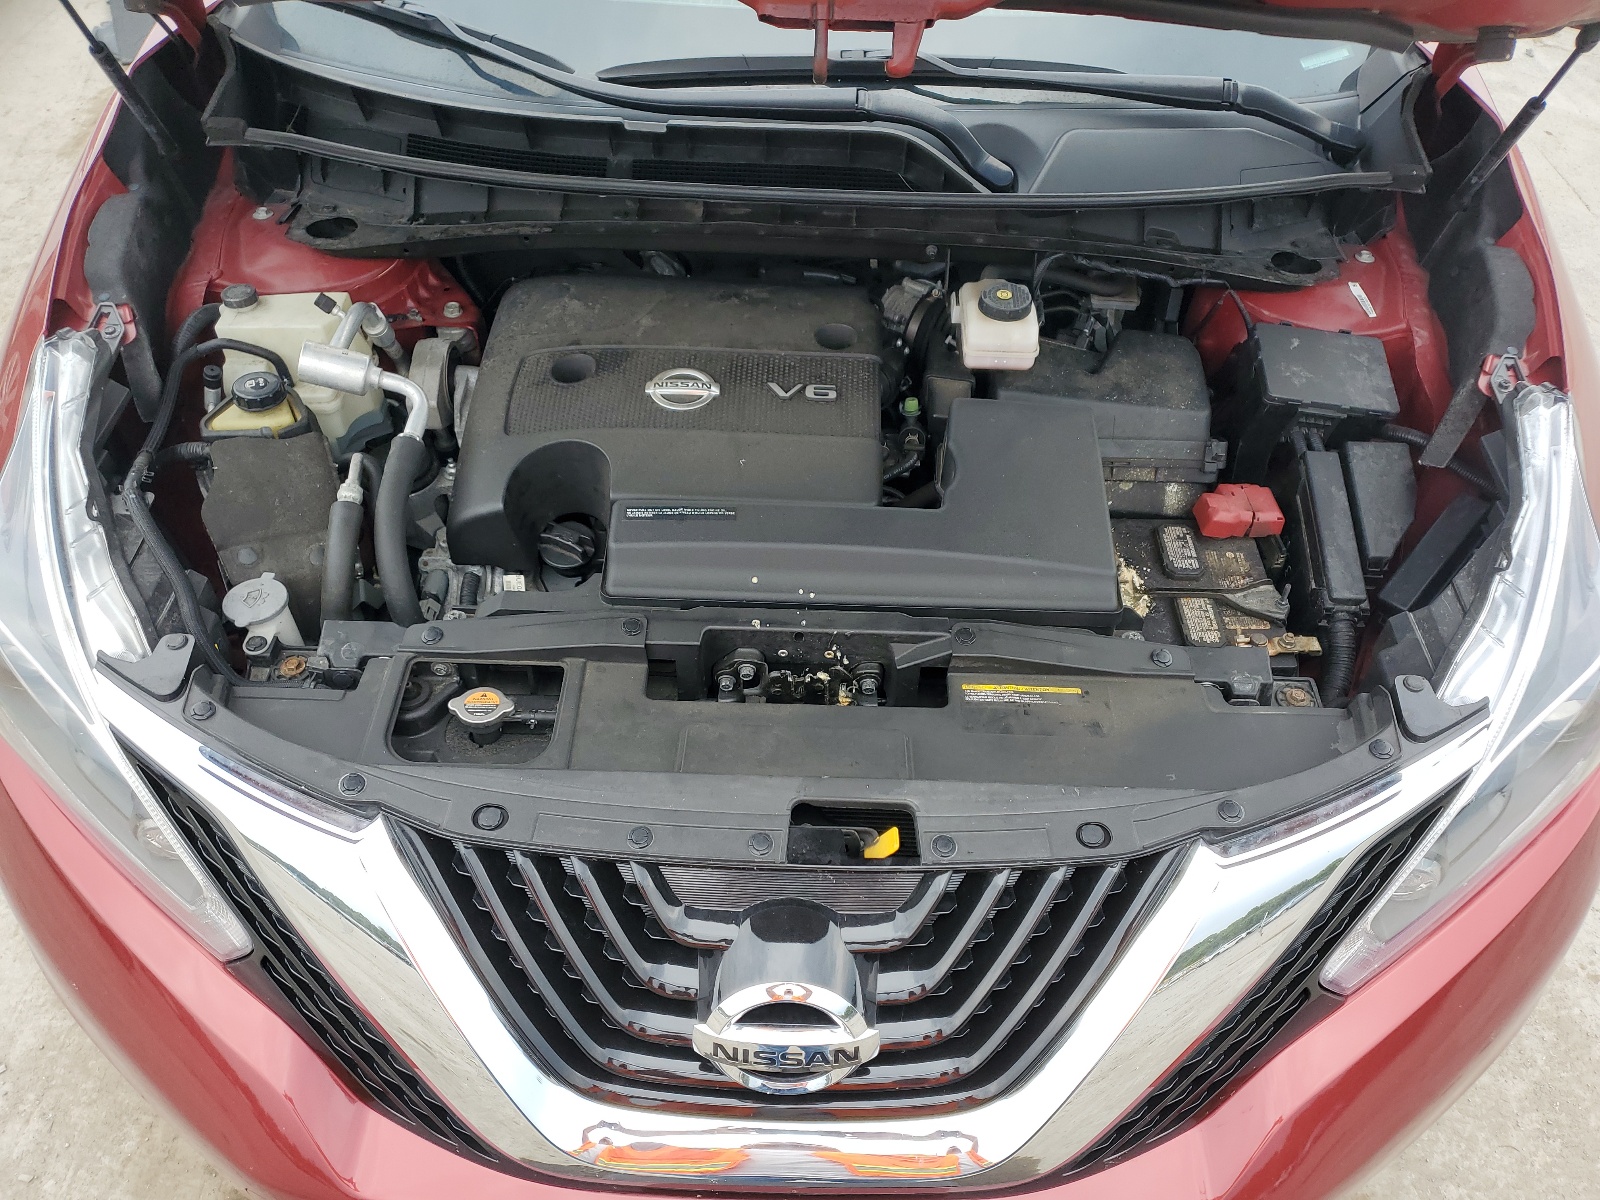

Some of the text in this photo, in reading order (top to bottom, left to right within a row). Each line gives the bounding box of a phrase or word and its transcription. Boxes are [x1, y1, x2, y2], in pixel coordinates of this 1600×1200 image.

[652, 381, 712, 390] NISSAN
[767, 381, 837, 402] V6
[712, 1041, 860, 1068] NISSAN
